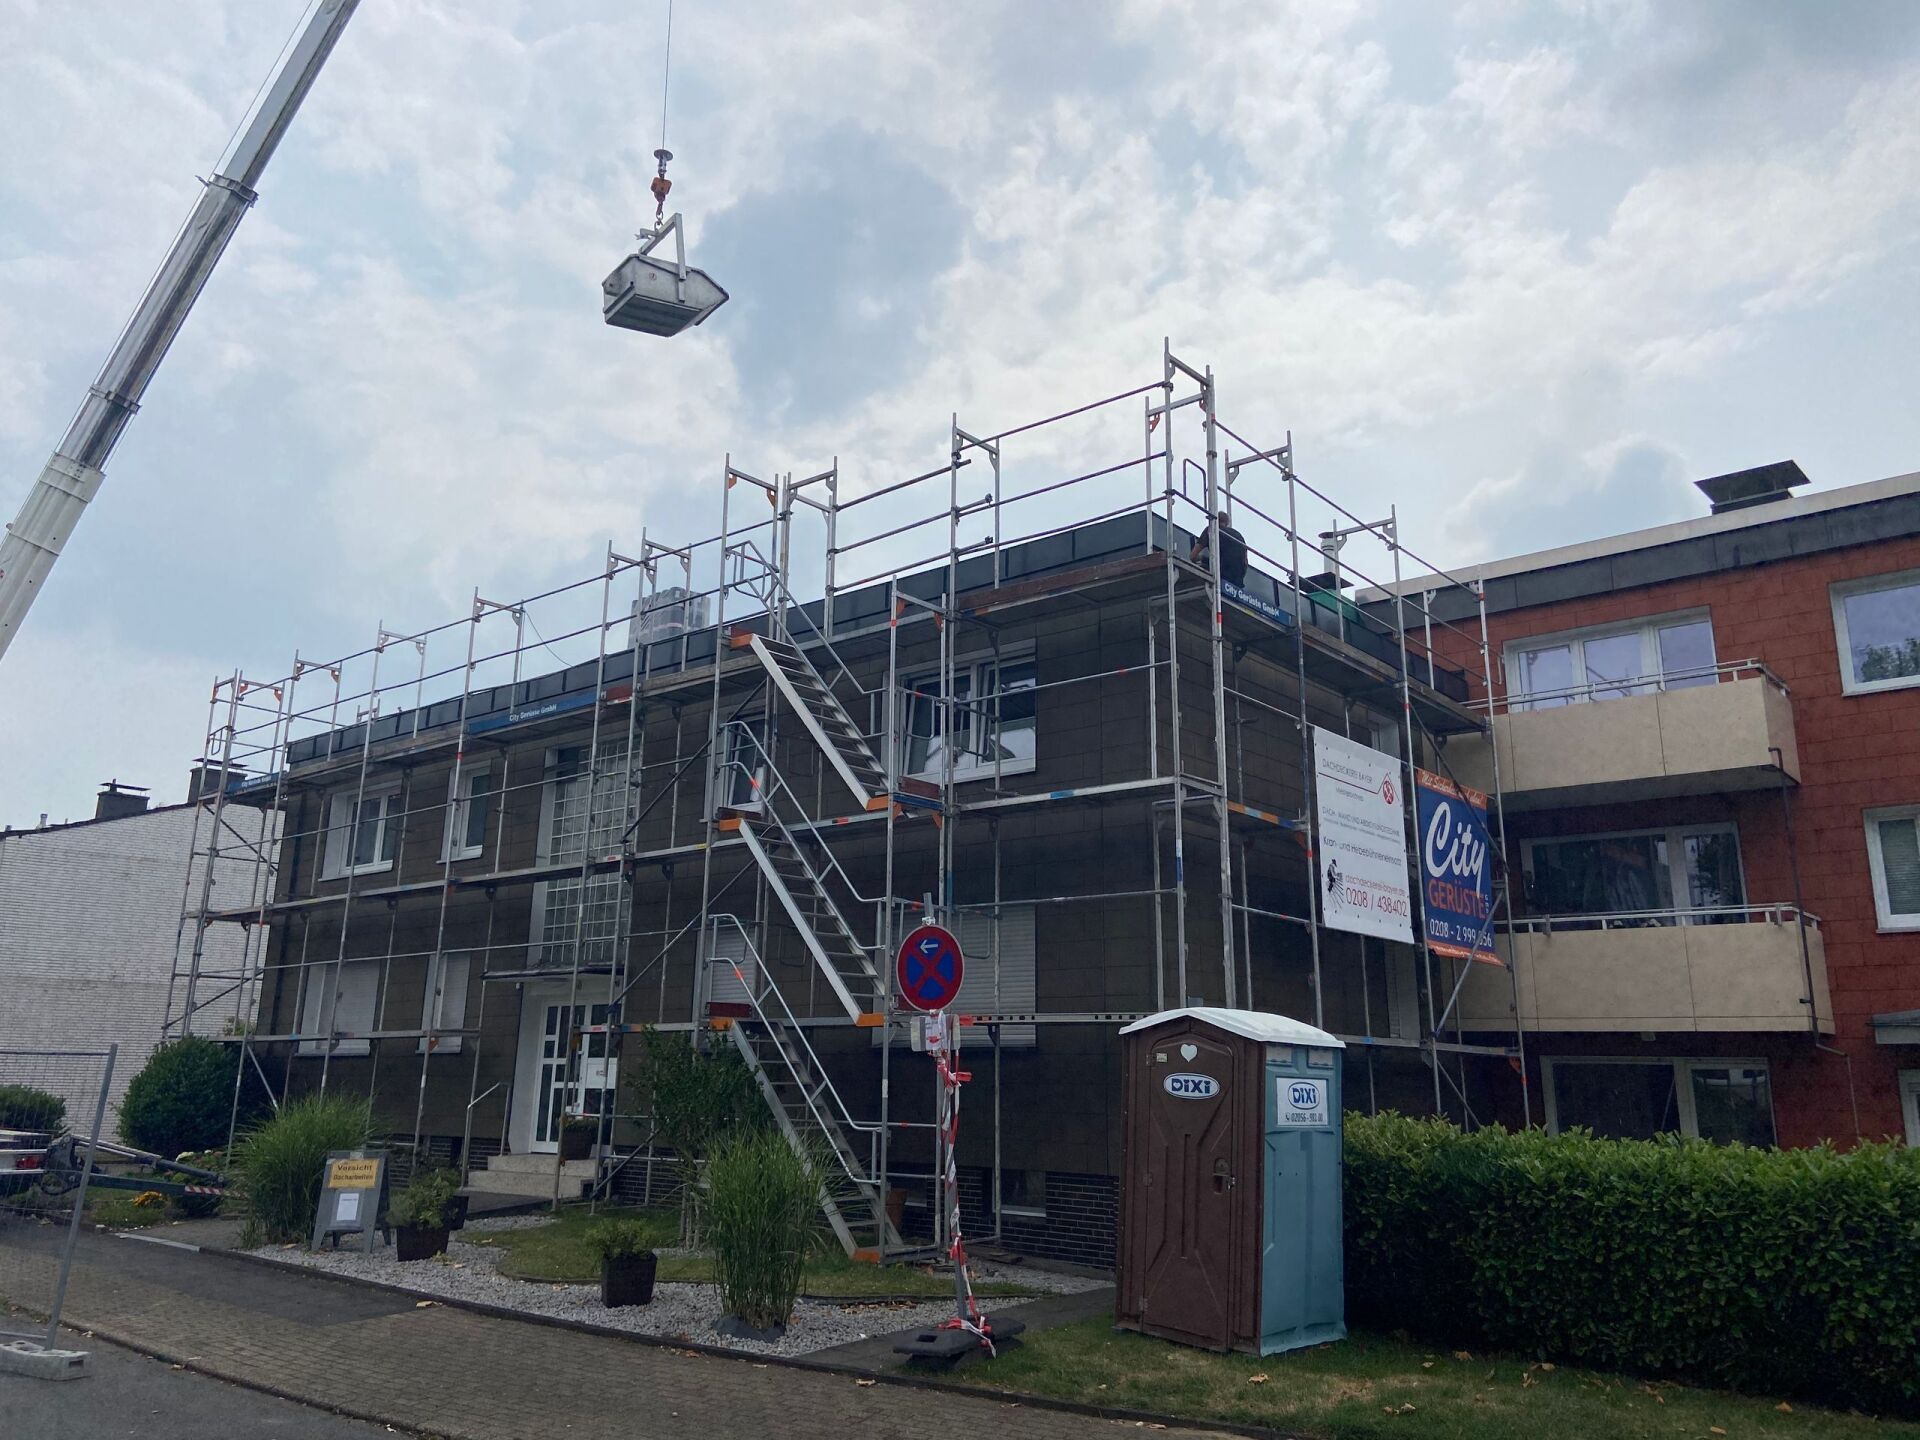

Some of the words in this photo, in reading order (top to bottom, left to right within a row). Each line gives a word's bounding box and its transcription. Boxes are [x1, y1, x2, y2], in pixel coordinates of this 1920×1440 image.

[1224, 583, 1238, 597] City
[1426, 802, 1485, 898] City
[1345, 887, 1368, 908] 0208
[1377, 895, 1408, 917] 438402
[1429, 879, 1489, 919] GERÜSTE
[1430, 918, 1449, 937] 0208
[1456, 925, 1461, 941] 2
[1462, 926, 1476, 944] 999
